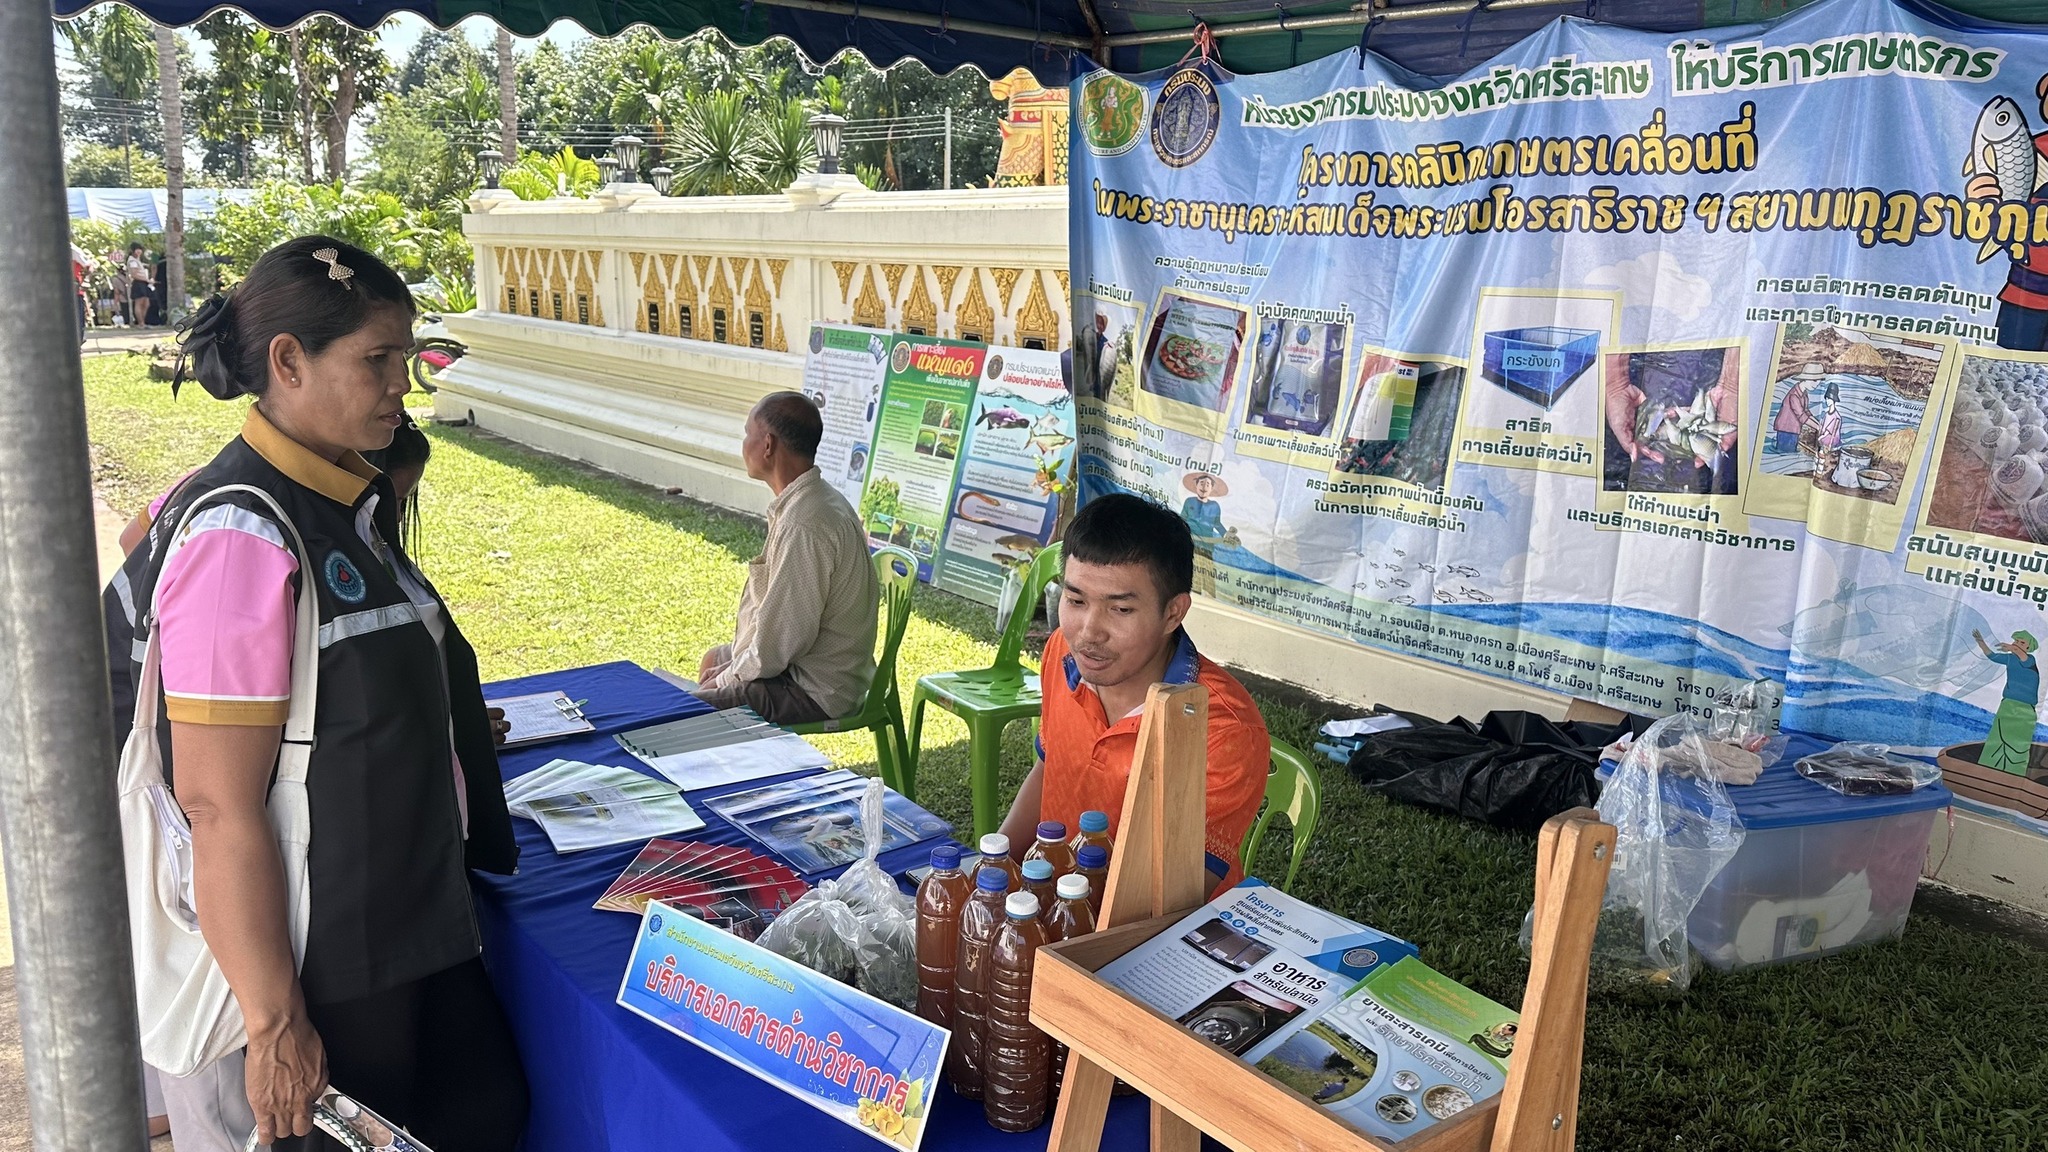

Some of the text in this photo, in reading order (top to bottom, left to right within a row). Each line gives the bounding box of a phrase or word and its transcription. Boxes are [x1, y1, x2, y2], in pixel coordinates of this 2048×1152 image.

[1673, 36, 1999, 92] ให้บริการเกษตรกร
[1174, 275, 1250, 296] ด้านการประมง
[1256, 301, 1355, 325] บำบัดคุณภาพน้ำ
[1506, 351, 1561, 369] กระชังบก
[1505, 417, 1552, 434] สาธิต
[1233, 428, 1341, 460] ในการเพาะเลี้ยงสัตว์น้ำ
[1462, 437, 1593, 465] การเลี้ยงสัตว์น้ำ
[1306, 477, 1484, 513] ตรวจวัดคุณภาพน้ำเบื้องต้น
[1627, 493, 1720, 525] ให้คำแนะนำ
[1314, 498, 1466, 533] ในการเพาะเลี้ยงสัตว์น้ำ
[1567, 507, 1796, 552] และบริการเอกสารวิชาการ
[1907, 533, 2048, 574] สนับสนุนพั
[1235, 577, 1373, 618] สำนักงานประมงจังหวัดศรีสะเกษ
[1380, 613, 1435, 634] ถ.รอบเมือง
[1438, 626, 1502, 650] ต.หนองครก
[1506, 641, 1596, 672] อ.เมืองศรีสะเกษ
[1599, 663, 1664, 689] จ.ศรีสะเกษ
[1676, 676, 1701, 695] โทร
[1471, 651, 1492, 666] 148
[1494, 658, 1515, 671] ม.8
[1518, 661, 1551, 681] ต.โพธิ์
[1553, 670, 1593, 692] อ.เมือง
[1597, 683, 1663, 710] จ.ศรีสะเกษ
[1245, 891, 1285, 918] โครงการ
[666, 925, 796, 995] สำนักงานประมงจังหวัดศรีสะเกษ
[1272, 961, 1328, 993] อาหาร
[1252, 970, 1320, 1006] สำหรับปลานิล
[645, 953, 912, 1115] บริการเอกสารด้านวิชาการ
[1362, 996, 1450, 1053] ยาและสารเคมี
[1376, 1022, 1483, 1094] รักษาโรคสัตว์น้ำ
